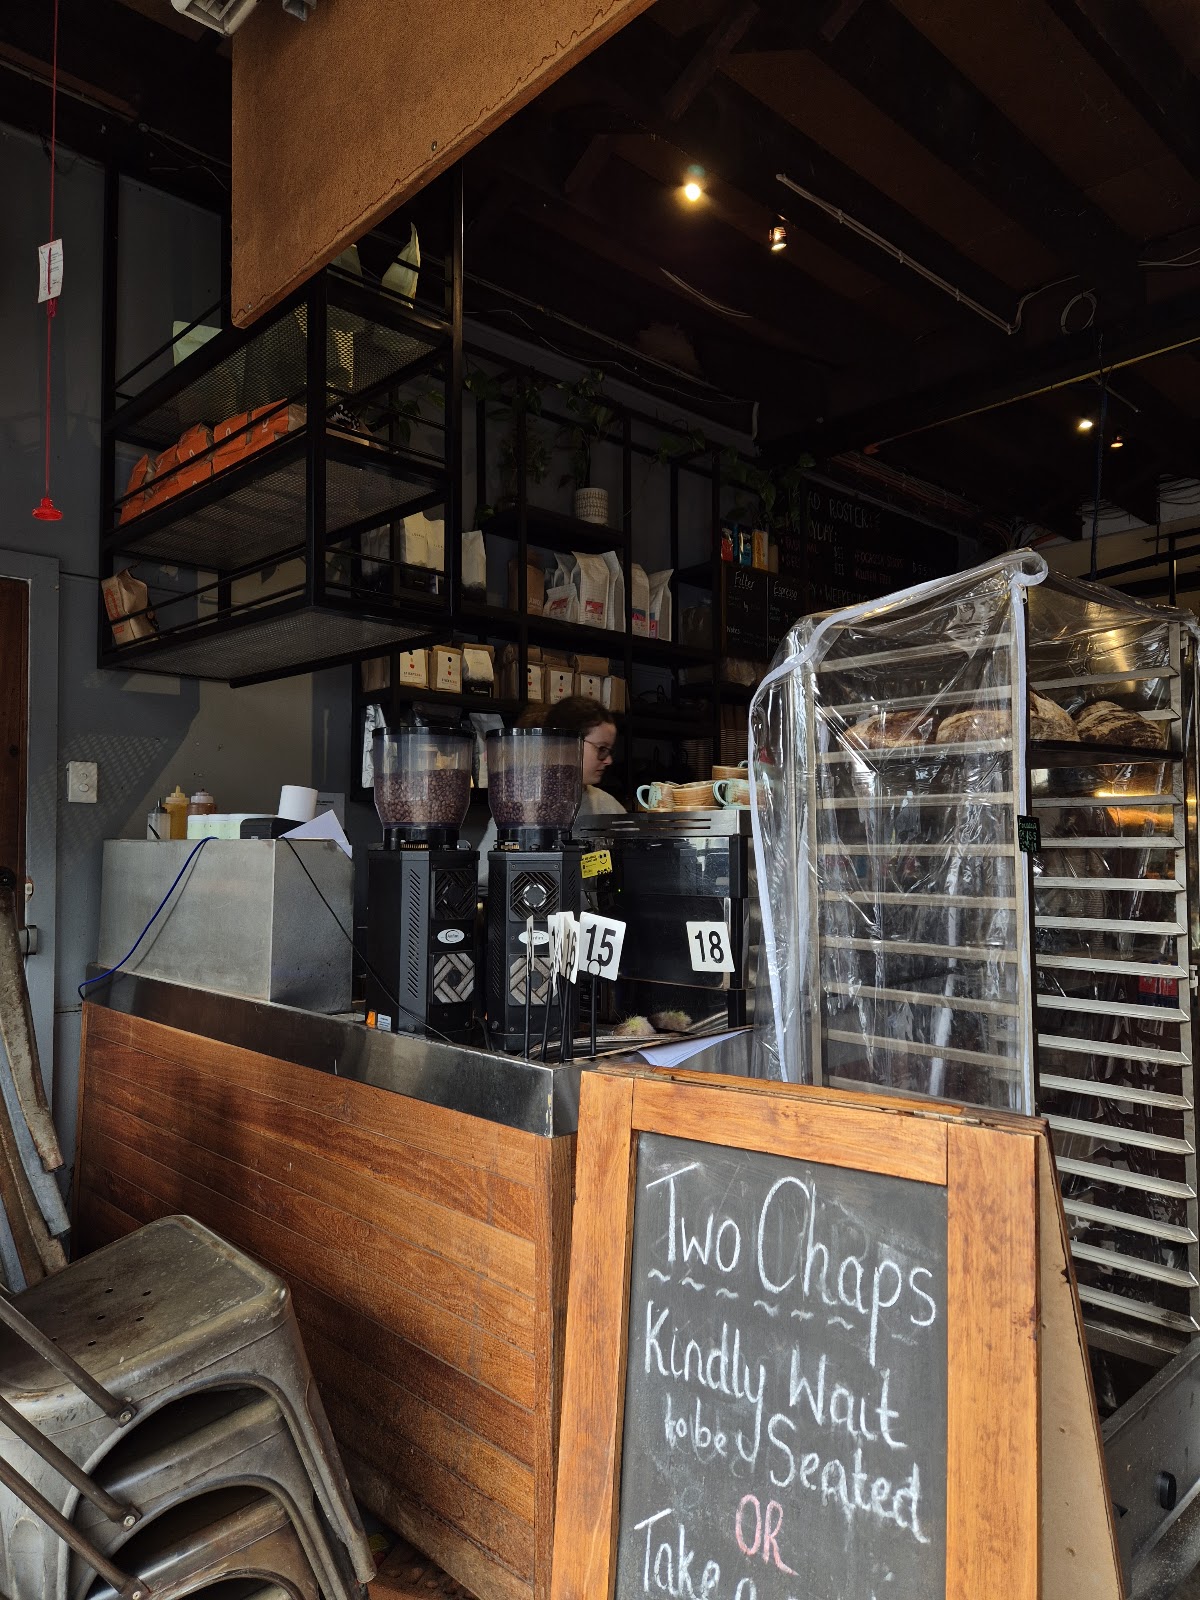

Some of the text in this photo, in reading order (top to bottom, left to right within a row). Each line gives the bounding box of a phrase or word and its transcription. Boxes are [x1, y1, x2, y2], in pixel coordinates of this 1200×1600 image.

[585, 923, 617, 968] 15
[694, 929, 725, 965] 18
[645, 1162, 937, 1368] Two Chaps
[643, 1299, 908, 1468] Kindly Wait
[768, 1412, 932, 1544] Seated
[633, 1507, 722, 1600] Take
[735, 1493, 801, 1577] OR
